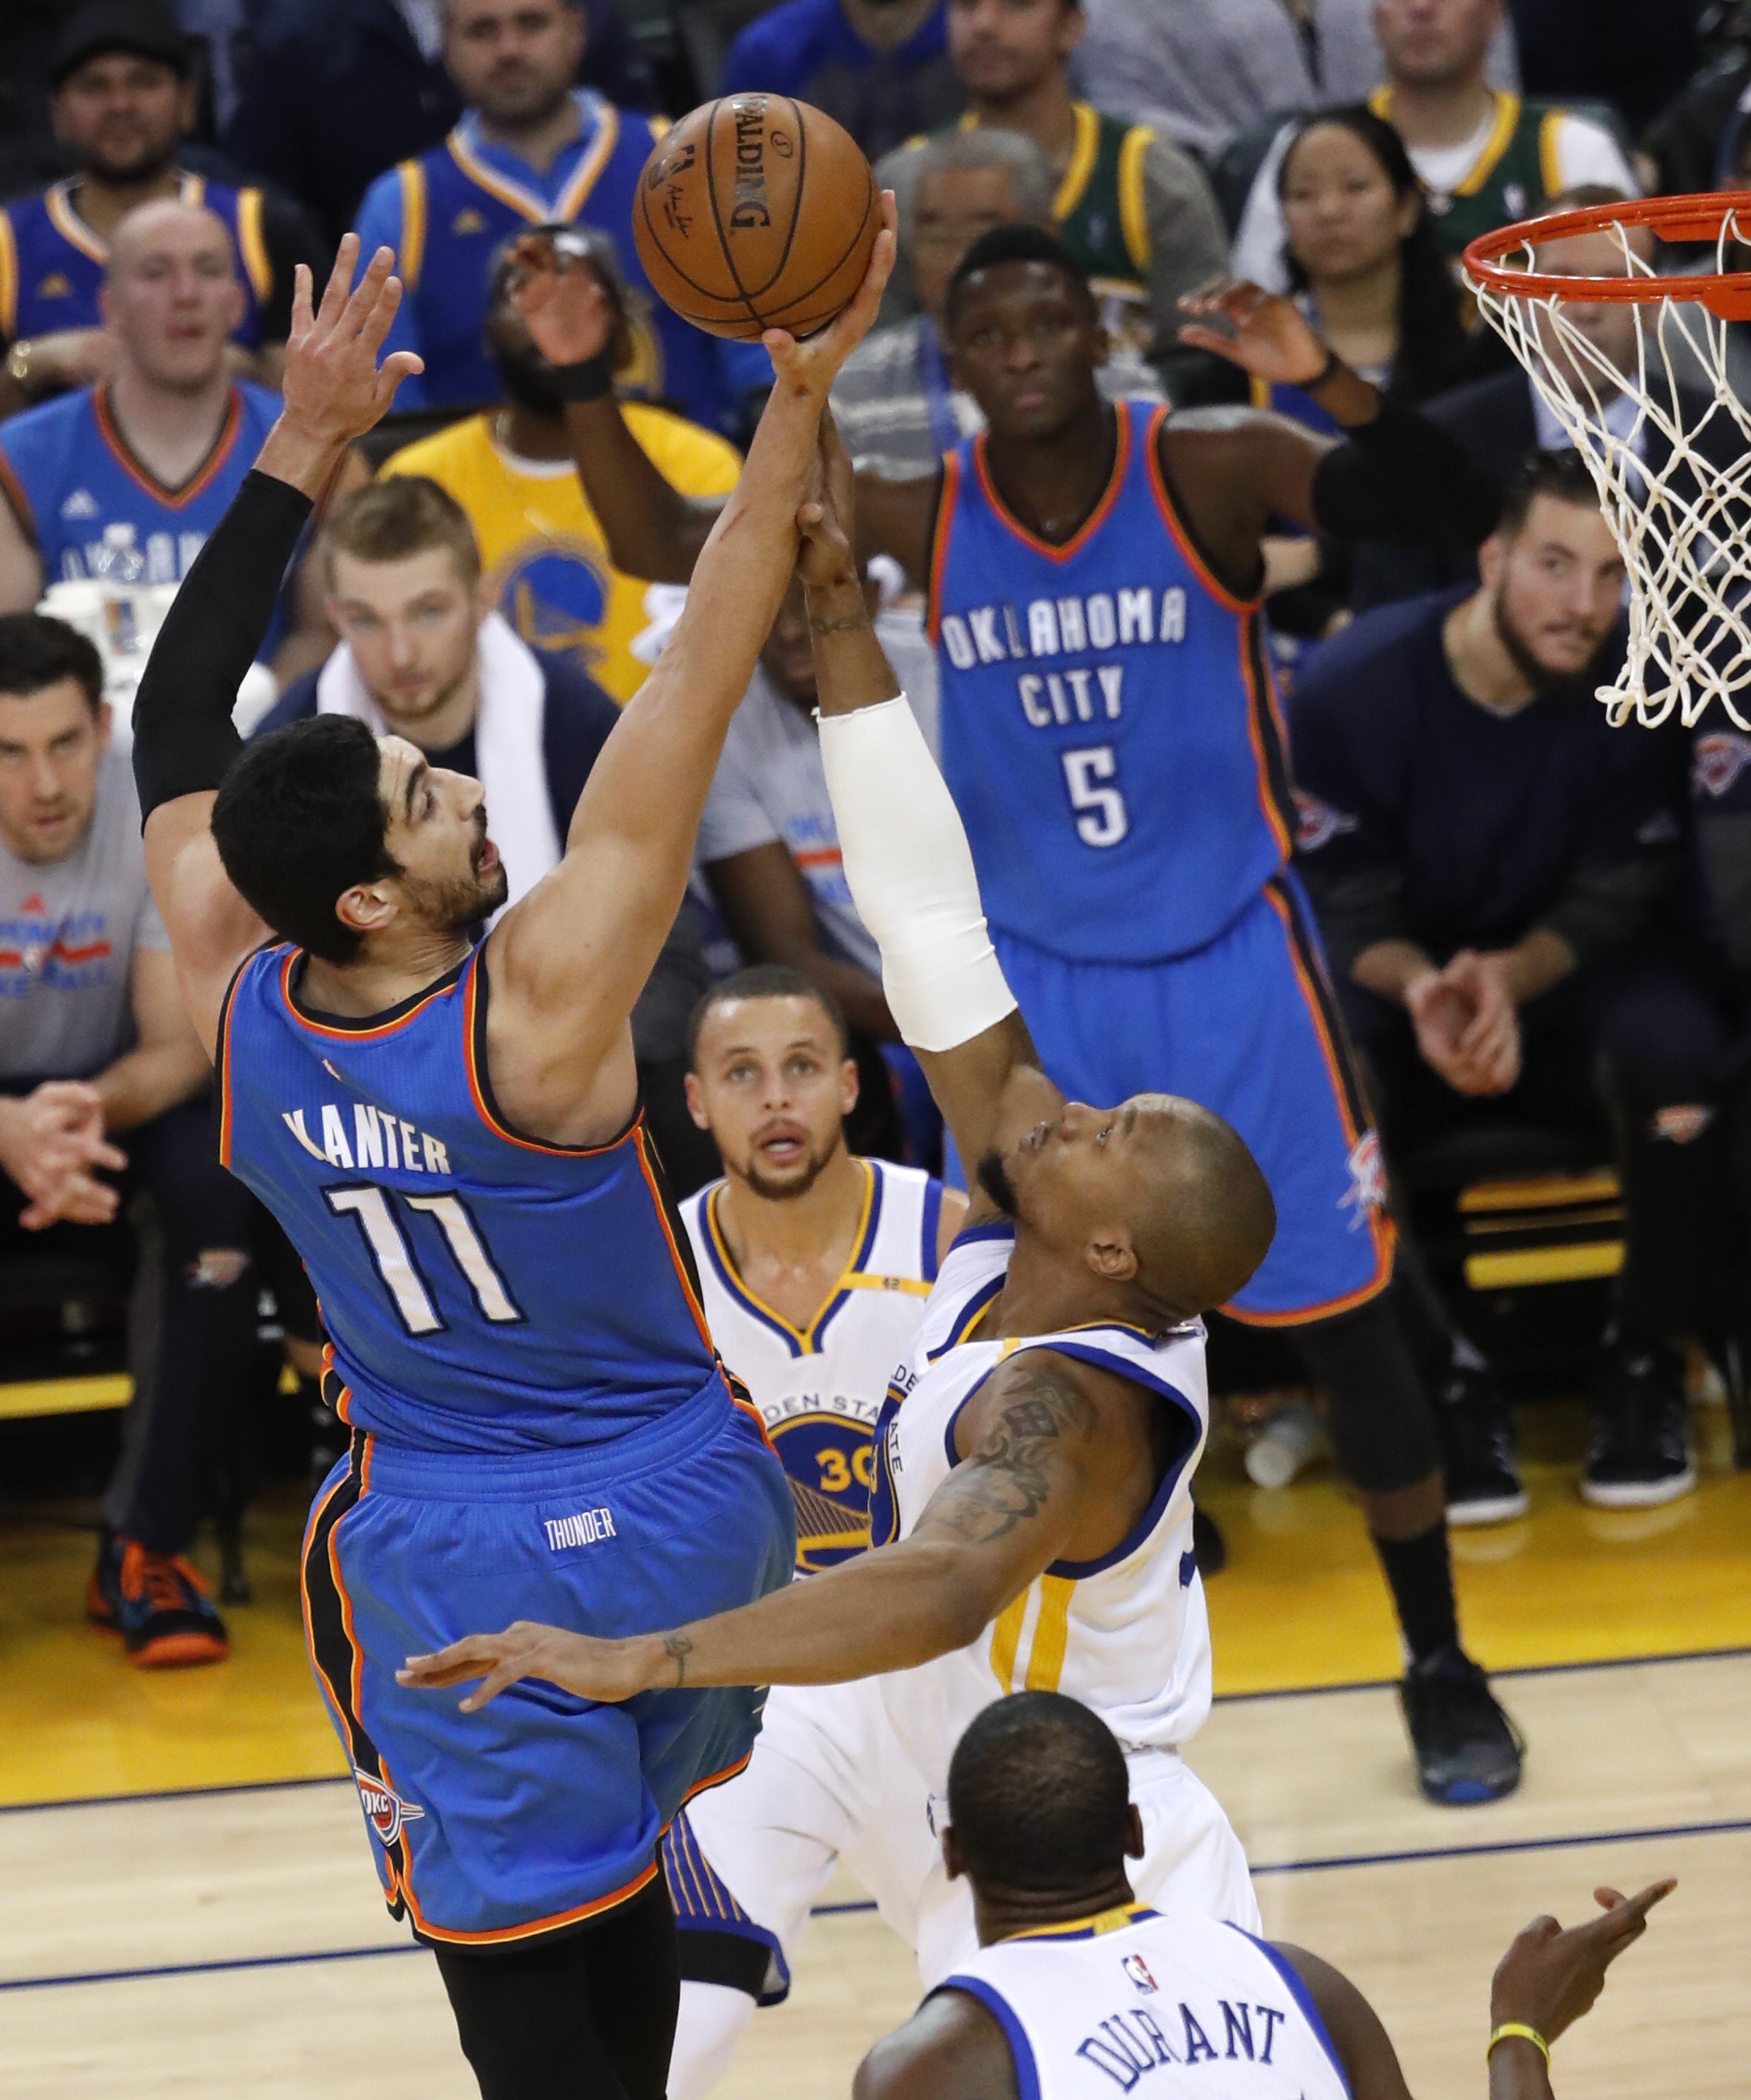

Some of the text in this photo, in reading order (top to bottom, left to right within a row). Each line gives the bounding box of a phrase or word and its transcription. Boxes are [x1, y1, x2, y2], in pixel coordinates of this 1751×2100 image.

[941, 586, 1187, 670] OKLAHOMA
[1018, 665, 1123, 727] CITY
[1061, 746, 1129, 846] 5
[322, 1181, 526, 1336] 11
[892, 1364, 918, 1392] DE
[544, 1507, 617, 1551] THUNDER
[361, 1789, 389, 1814] OKC
[1074, 2000, 1285, 2095] DURANT
